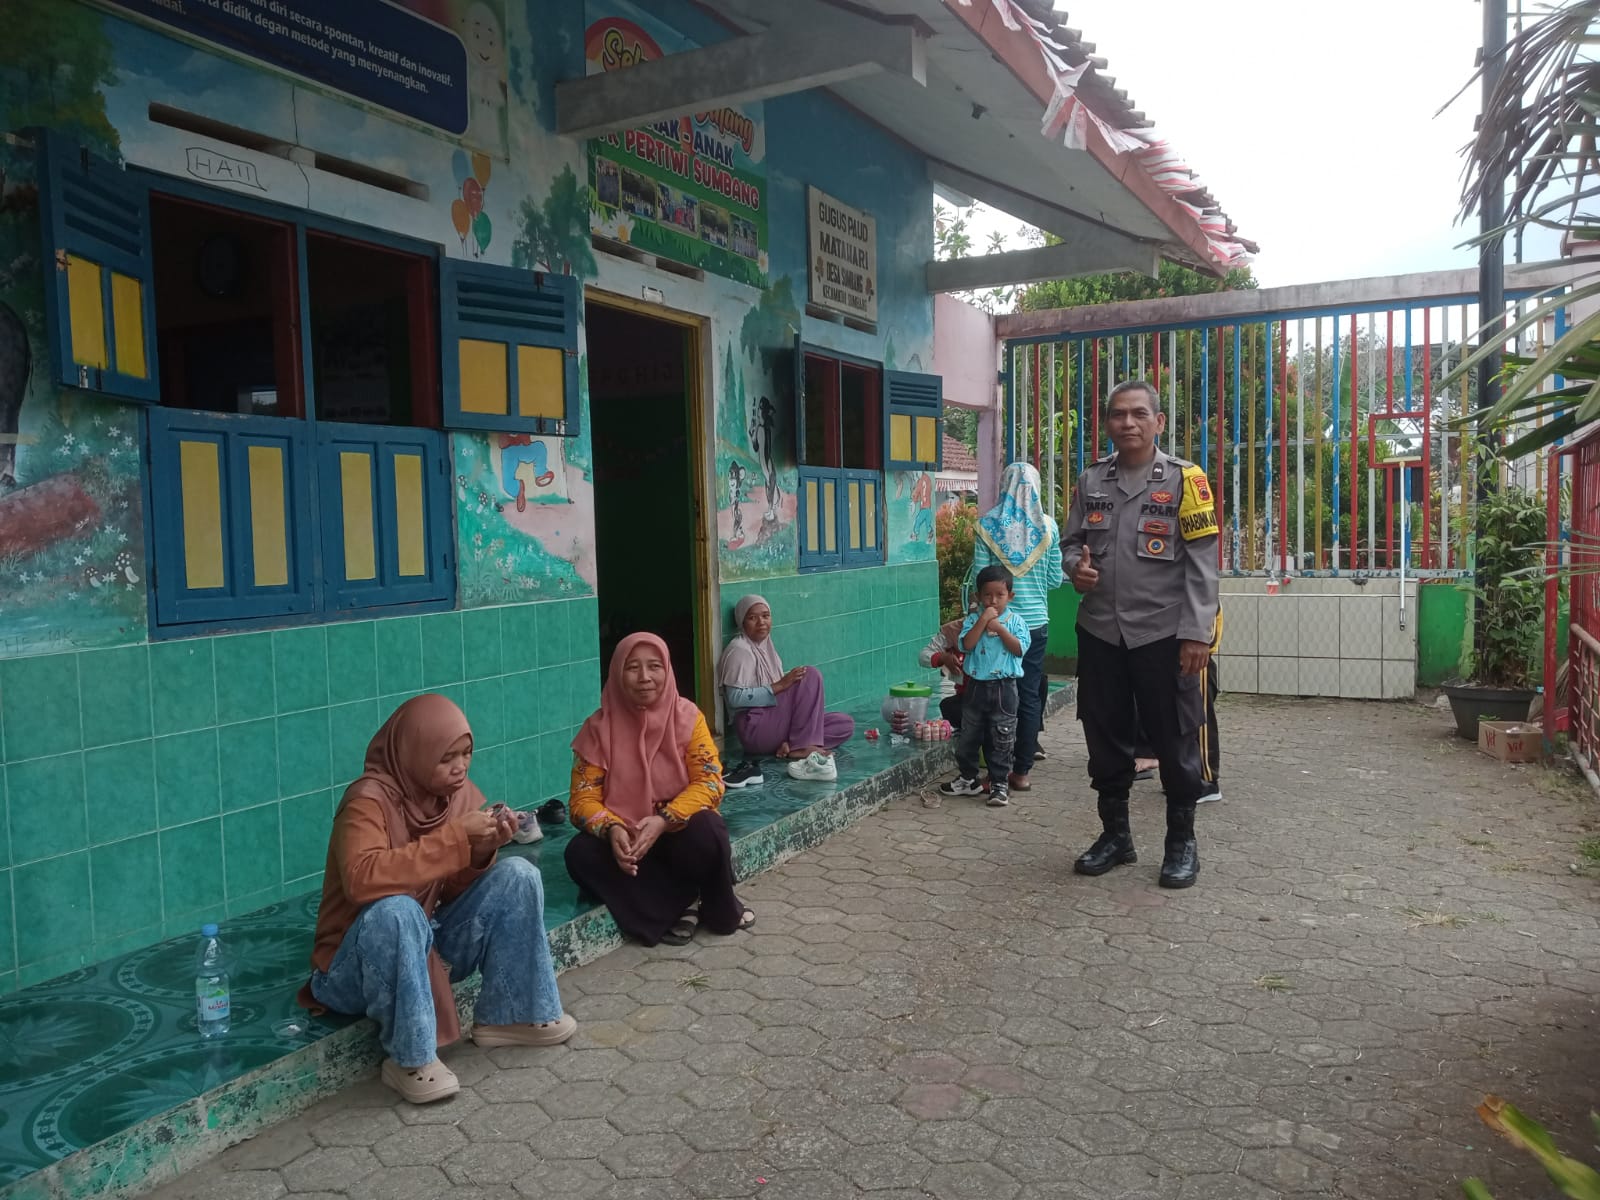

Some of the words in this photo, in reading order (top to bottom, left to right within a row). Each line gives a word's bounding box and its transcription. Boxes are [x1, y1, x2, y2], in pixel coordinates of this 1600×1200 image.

[222, 0, 252, 23] didik
[254, 13, 289, 37] degan
[291, 29, 330, 53] metode
[331, 47, 356, 67] yang
[357, 57, 429, 94] menyenangkan.
[268, 1, 287, 17] diri
[289, 9, 323, 32] secara
[324, 25, 367, 52] spontan,
[368, 41, 400, 64] kreatif
[400, 56, 418, 72] dan
[418, 62, 453, 87] inovatif.
[624, 128, 690, 179] PERTIWI
[692, 157, 760, 211] SUMBANG
[818, 202, 847, 233] GUGUS
[847, 216, 869, 242] PAUD
